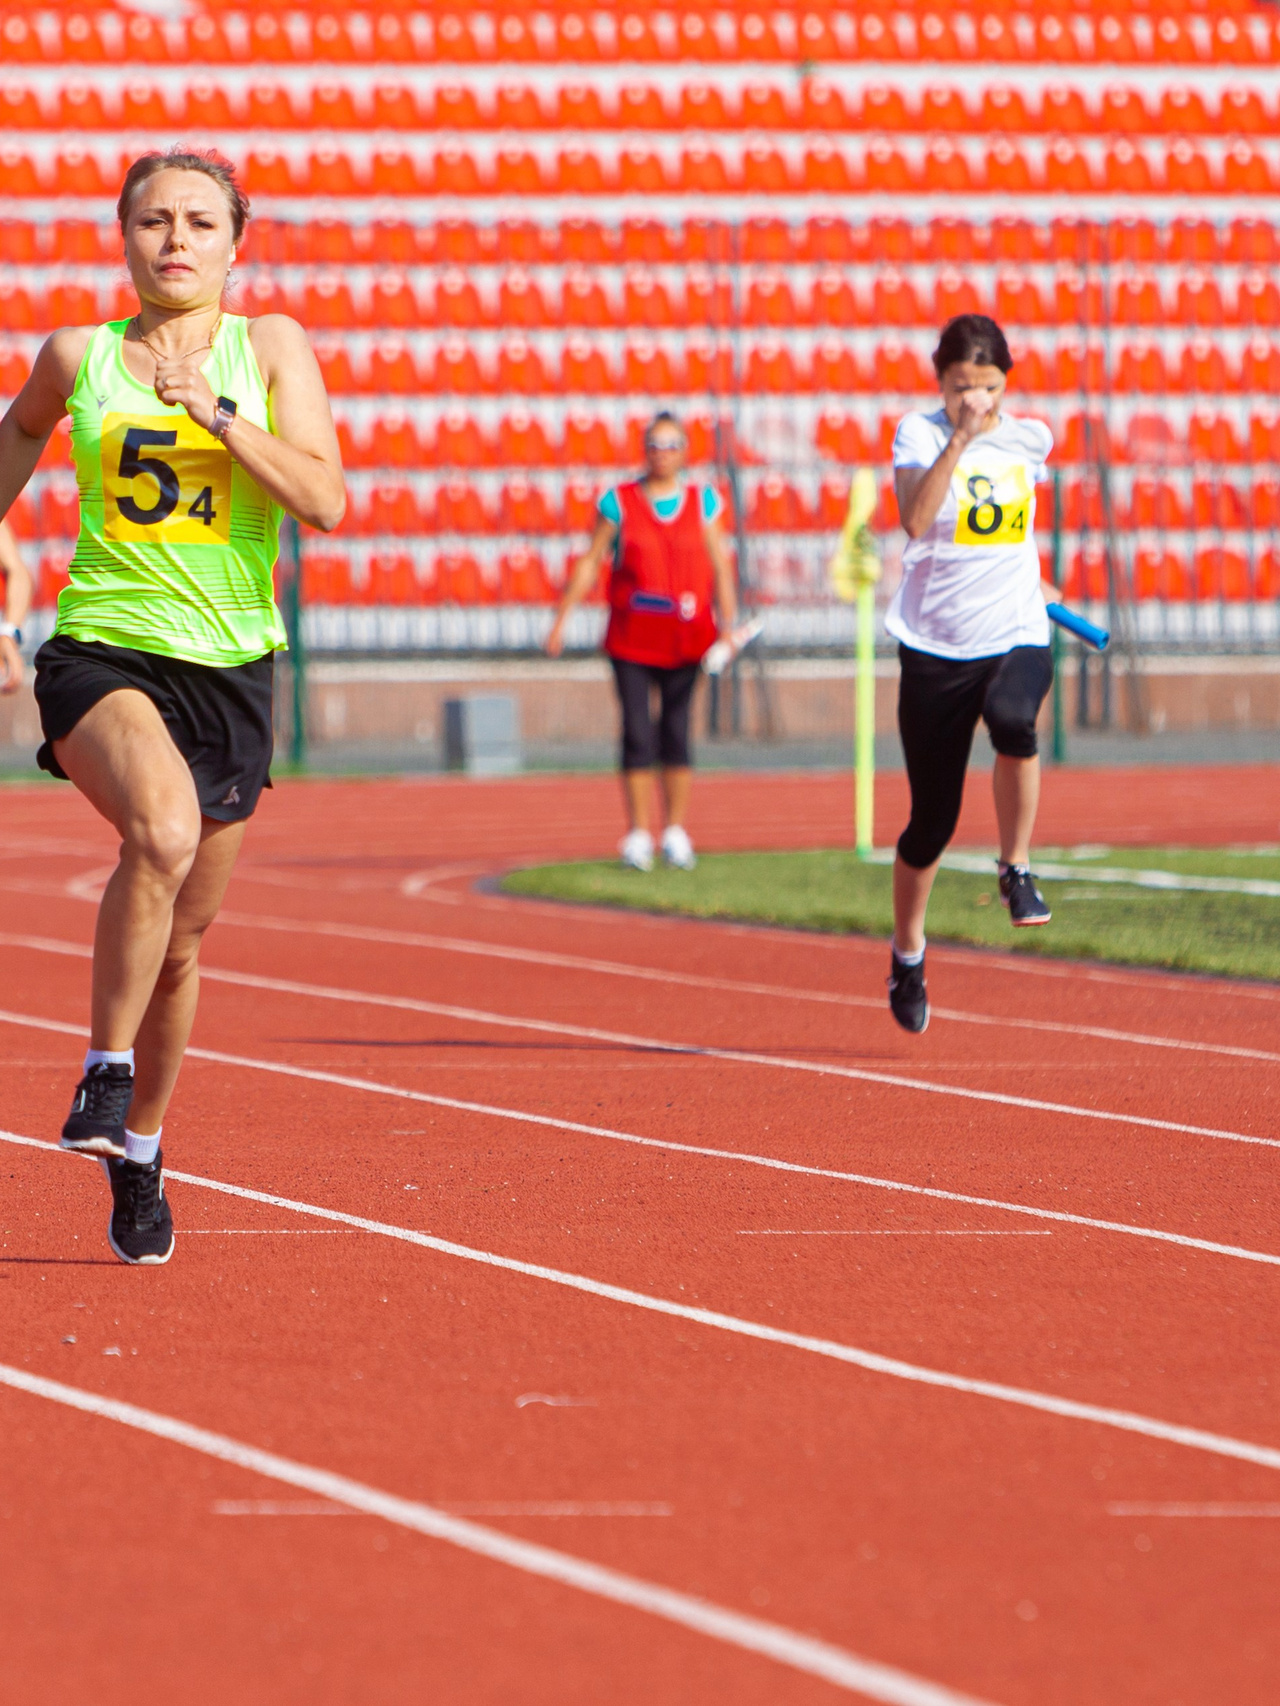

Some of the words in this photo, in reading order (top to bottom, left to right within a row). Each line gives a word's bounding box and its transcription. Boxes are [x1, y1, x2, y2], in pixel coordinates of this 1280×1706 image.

[116, 428, 179, 525] 5
[188, 486, 216, 526] 4
[967, 475, 1003, 535] 8
[1011, 510, 1024, 533] 4
